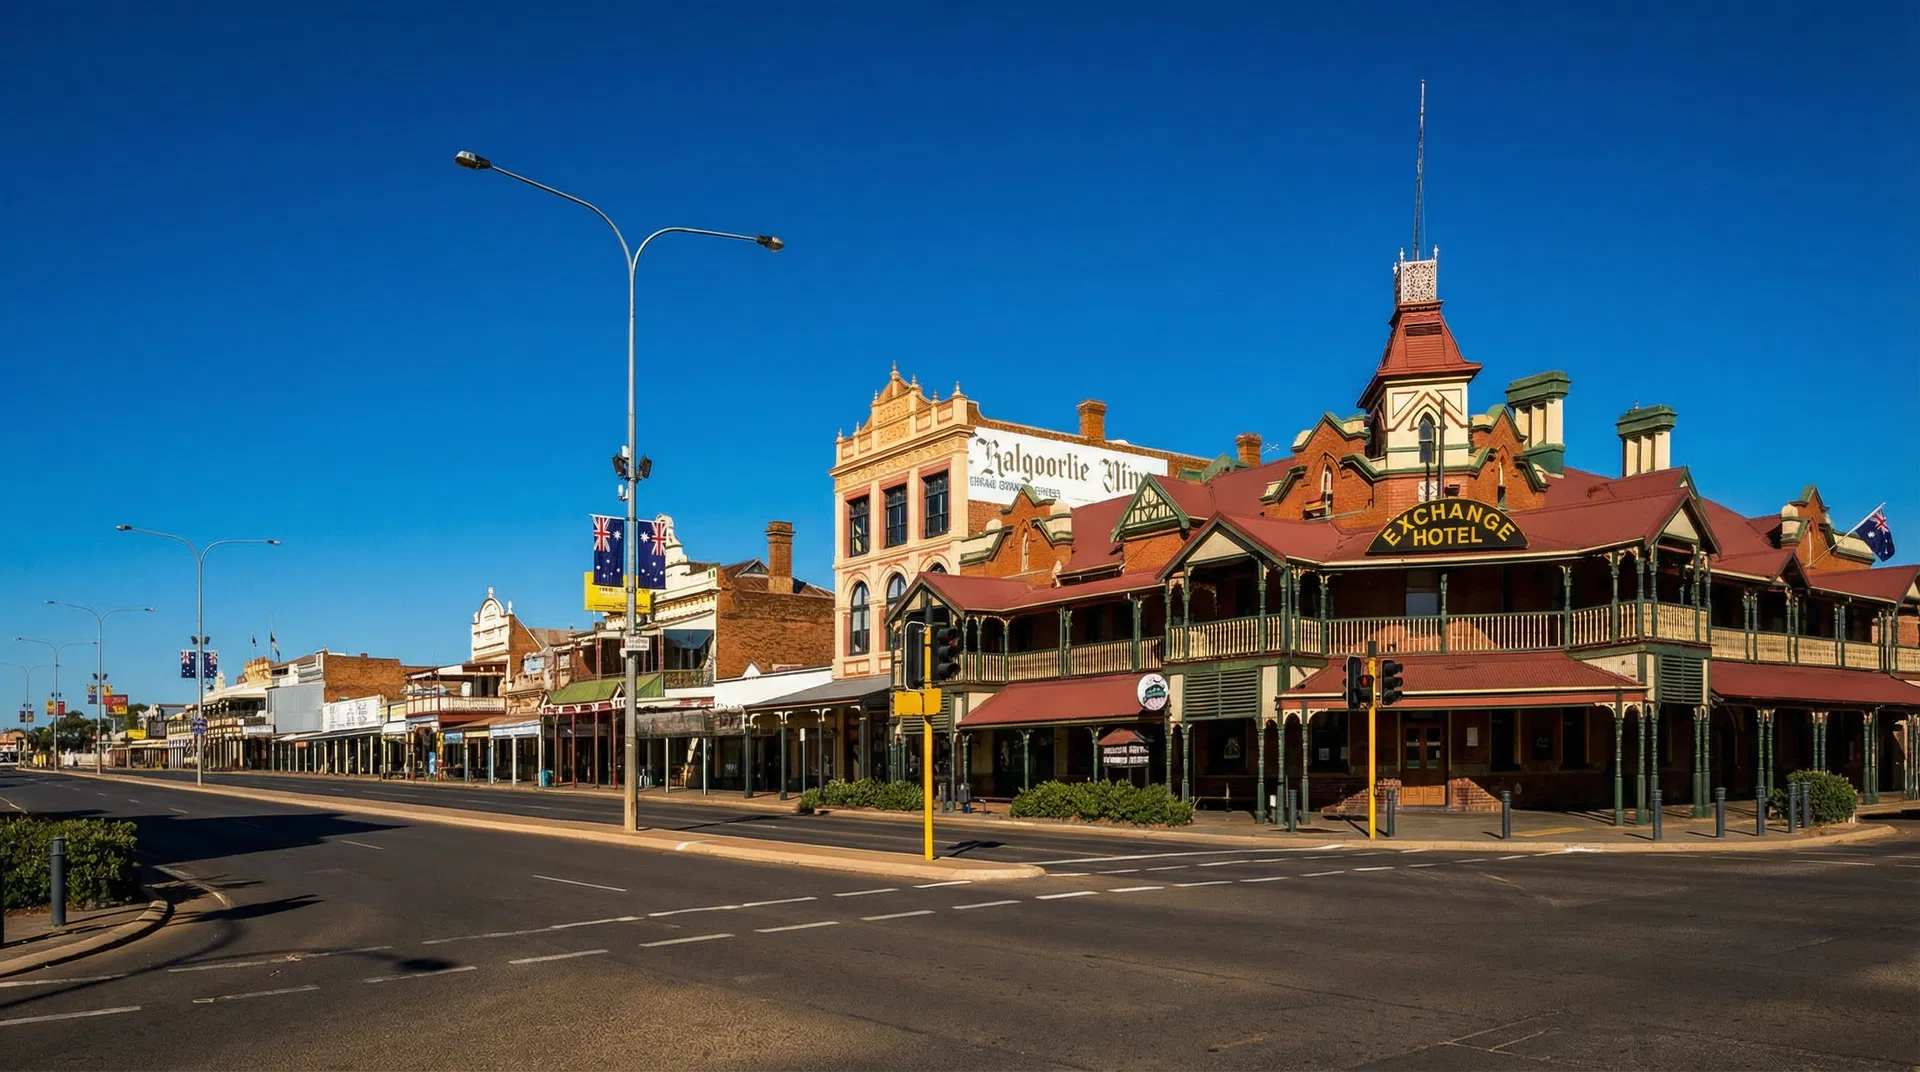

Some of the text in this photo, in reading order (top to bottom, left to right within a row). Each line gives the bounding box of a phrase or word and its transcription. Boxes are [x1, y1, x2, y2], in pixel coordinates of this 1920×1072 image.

[976, 437, 1090, 484] Kalgoorlie
[1382, 503, 1516, 547] EXCHANGE
[1413, 526, 1484, 547] HOTEL
